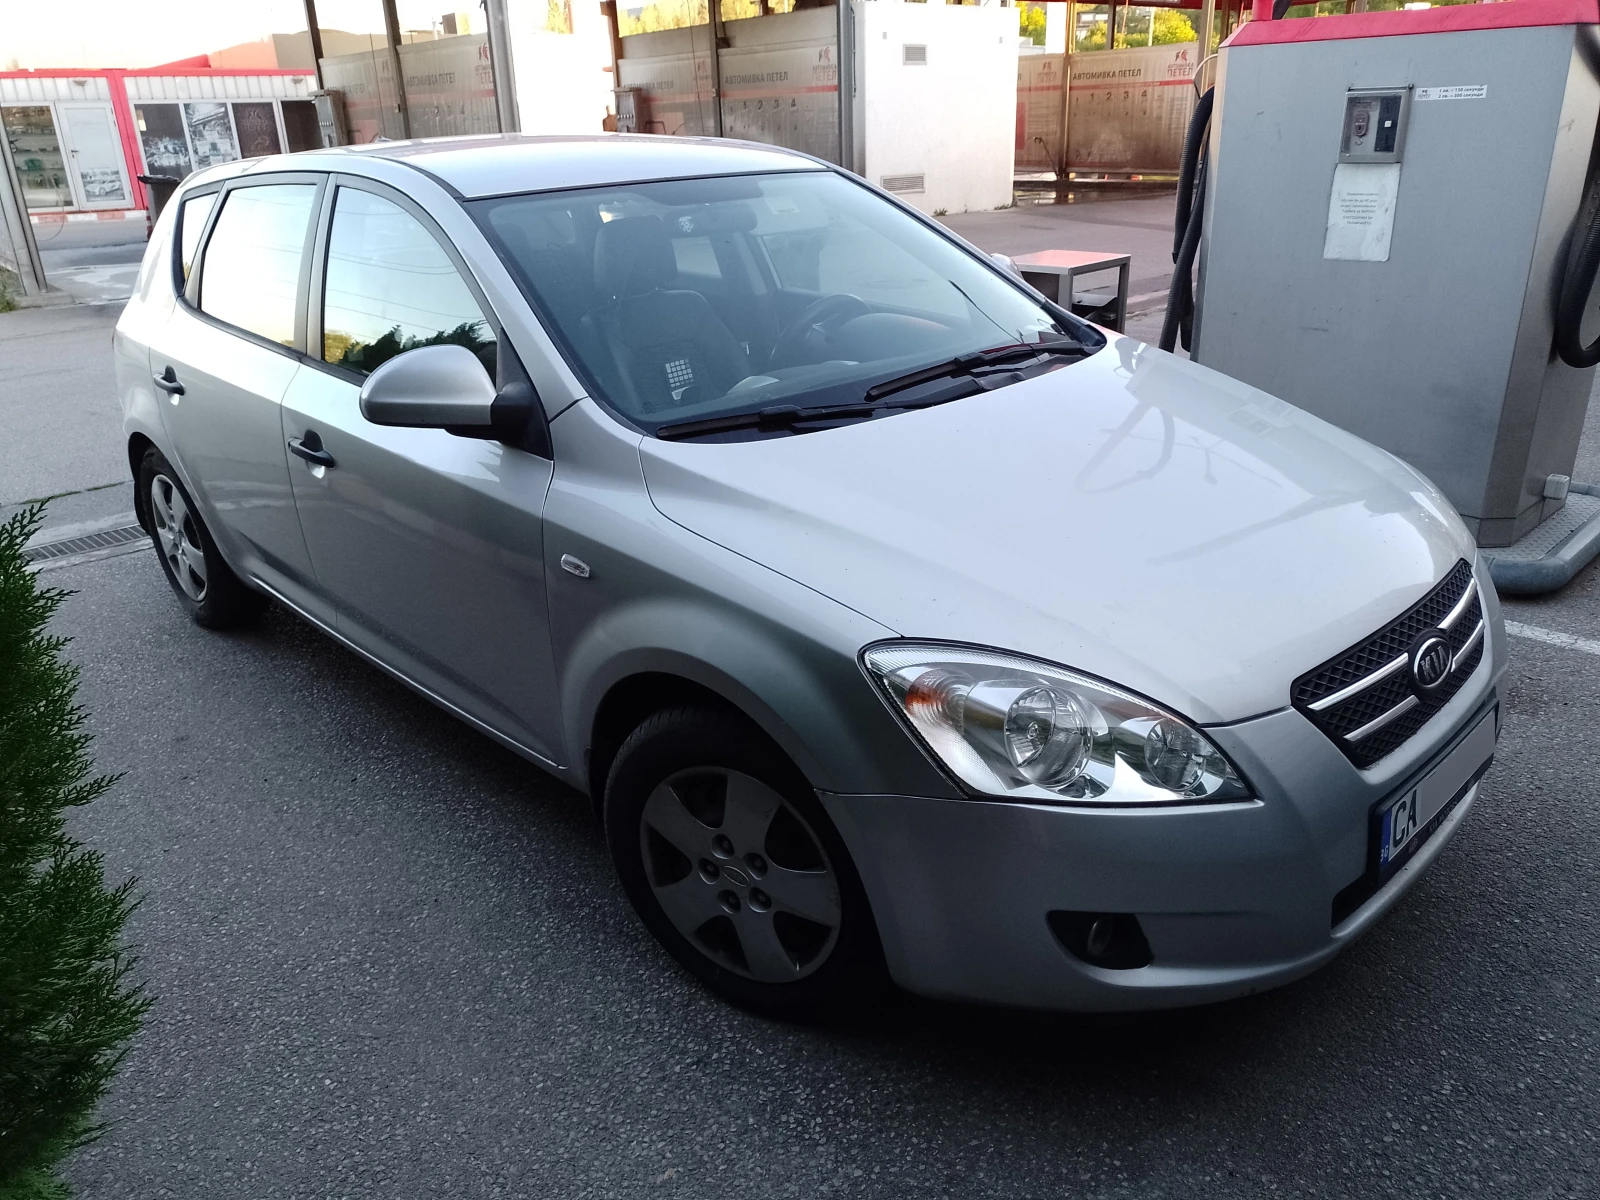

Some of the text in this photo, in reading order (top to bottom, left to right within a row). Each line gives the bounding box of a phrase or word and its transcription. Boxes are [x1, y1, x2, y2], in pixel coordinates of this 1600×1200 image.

[724, 71, 789, 84] АВТОМИВКА ПЕТЕЛ
[813, 70, 837, 80] ПЕТЕЛ
[1073, 68, 1141, 81] АВТОМИВКА ПЕТЕЛ
[1167, 67, 1193, 77] ПЕТЕЛ
[1107, 92, 1112, 100] 2
[1124, 91, 1129, 99] 3
[758, 100, 763, 110] 2
[774, 100, 780, 108] 3
[791, 98, 796, 107] 4
[1419, 645, 1450, 682] KIA
[1392, 788, 1418, 849] CA
